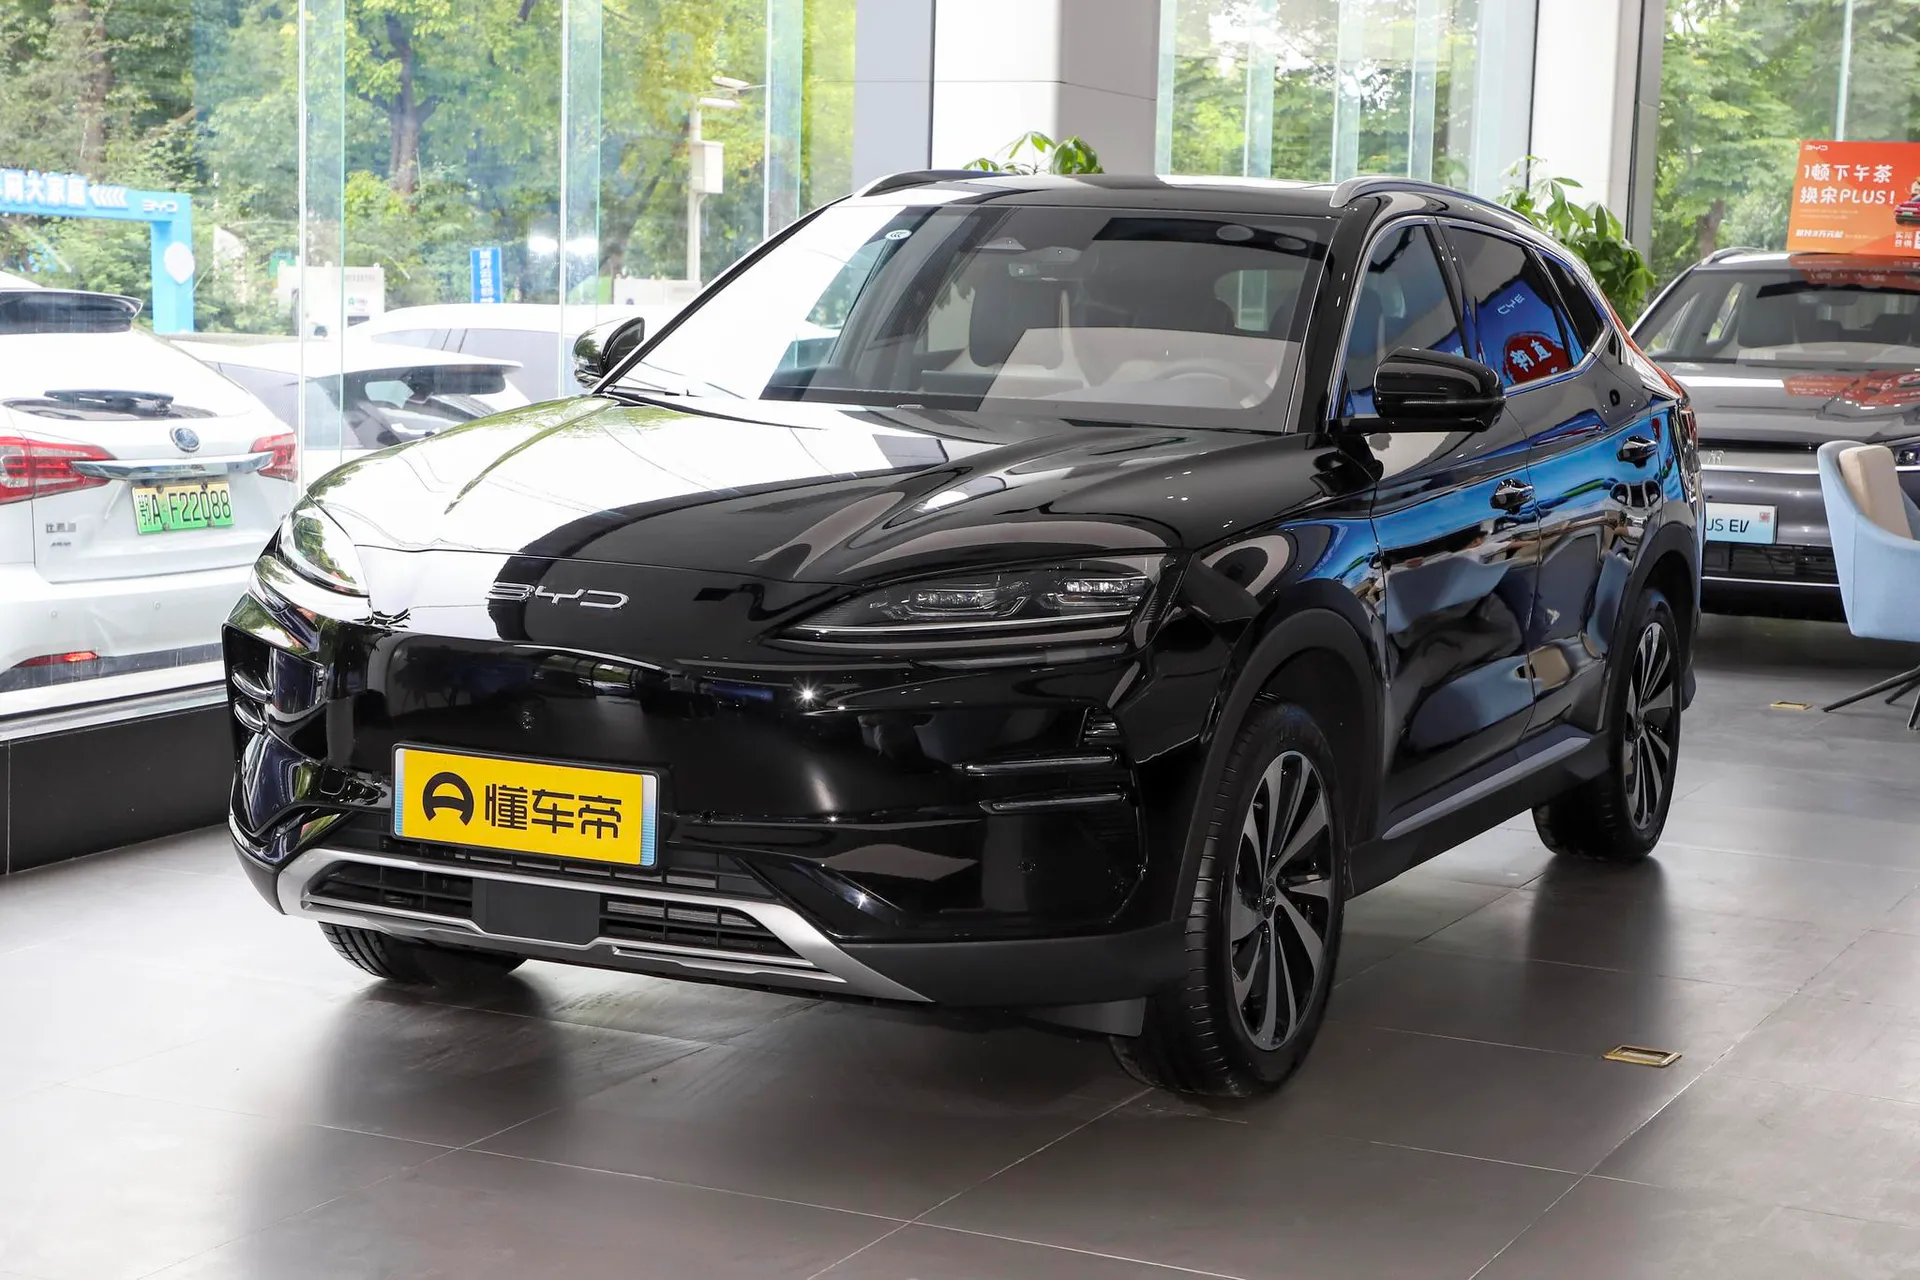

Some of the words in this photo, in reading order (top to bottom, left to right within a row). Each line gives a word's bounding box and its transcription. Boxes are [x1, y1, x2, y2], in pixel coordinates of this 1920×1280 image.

[1803, 163, 1893, 183] 1顿下午茶
[1799, 186, 1896, 204] 换宋PLUS!
[168, 489, 232, 524] F22088
[1729, 519, 1750, 533] EV
[485, 581, 630, 609] BYD
[485, 783, 622, 839] 懂车帝
